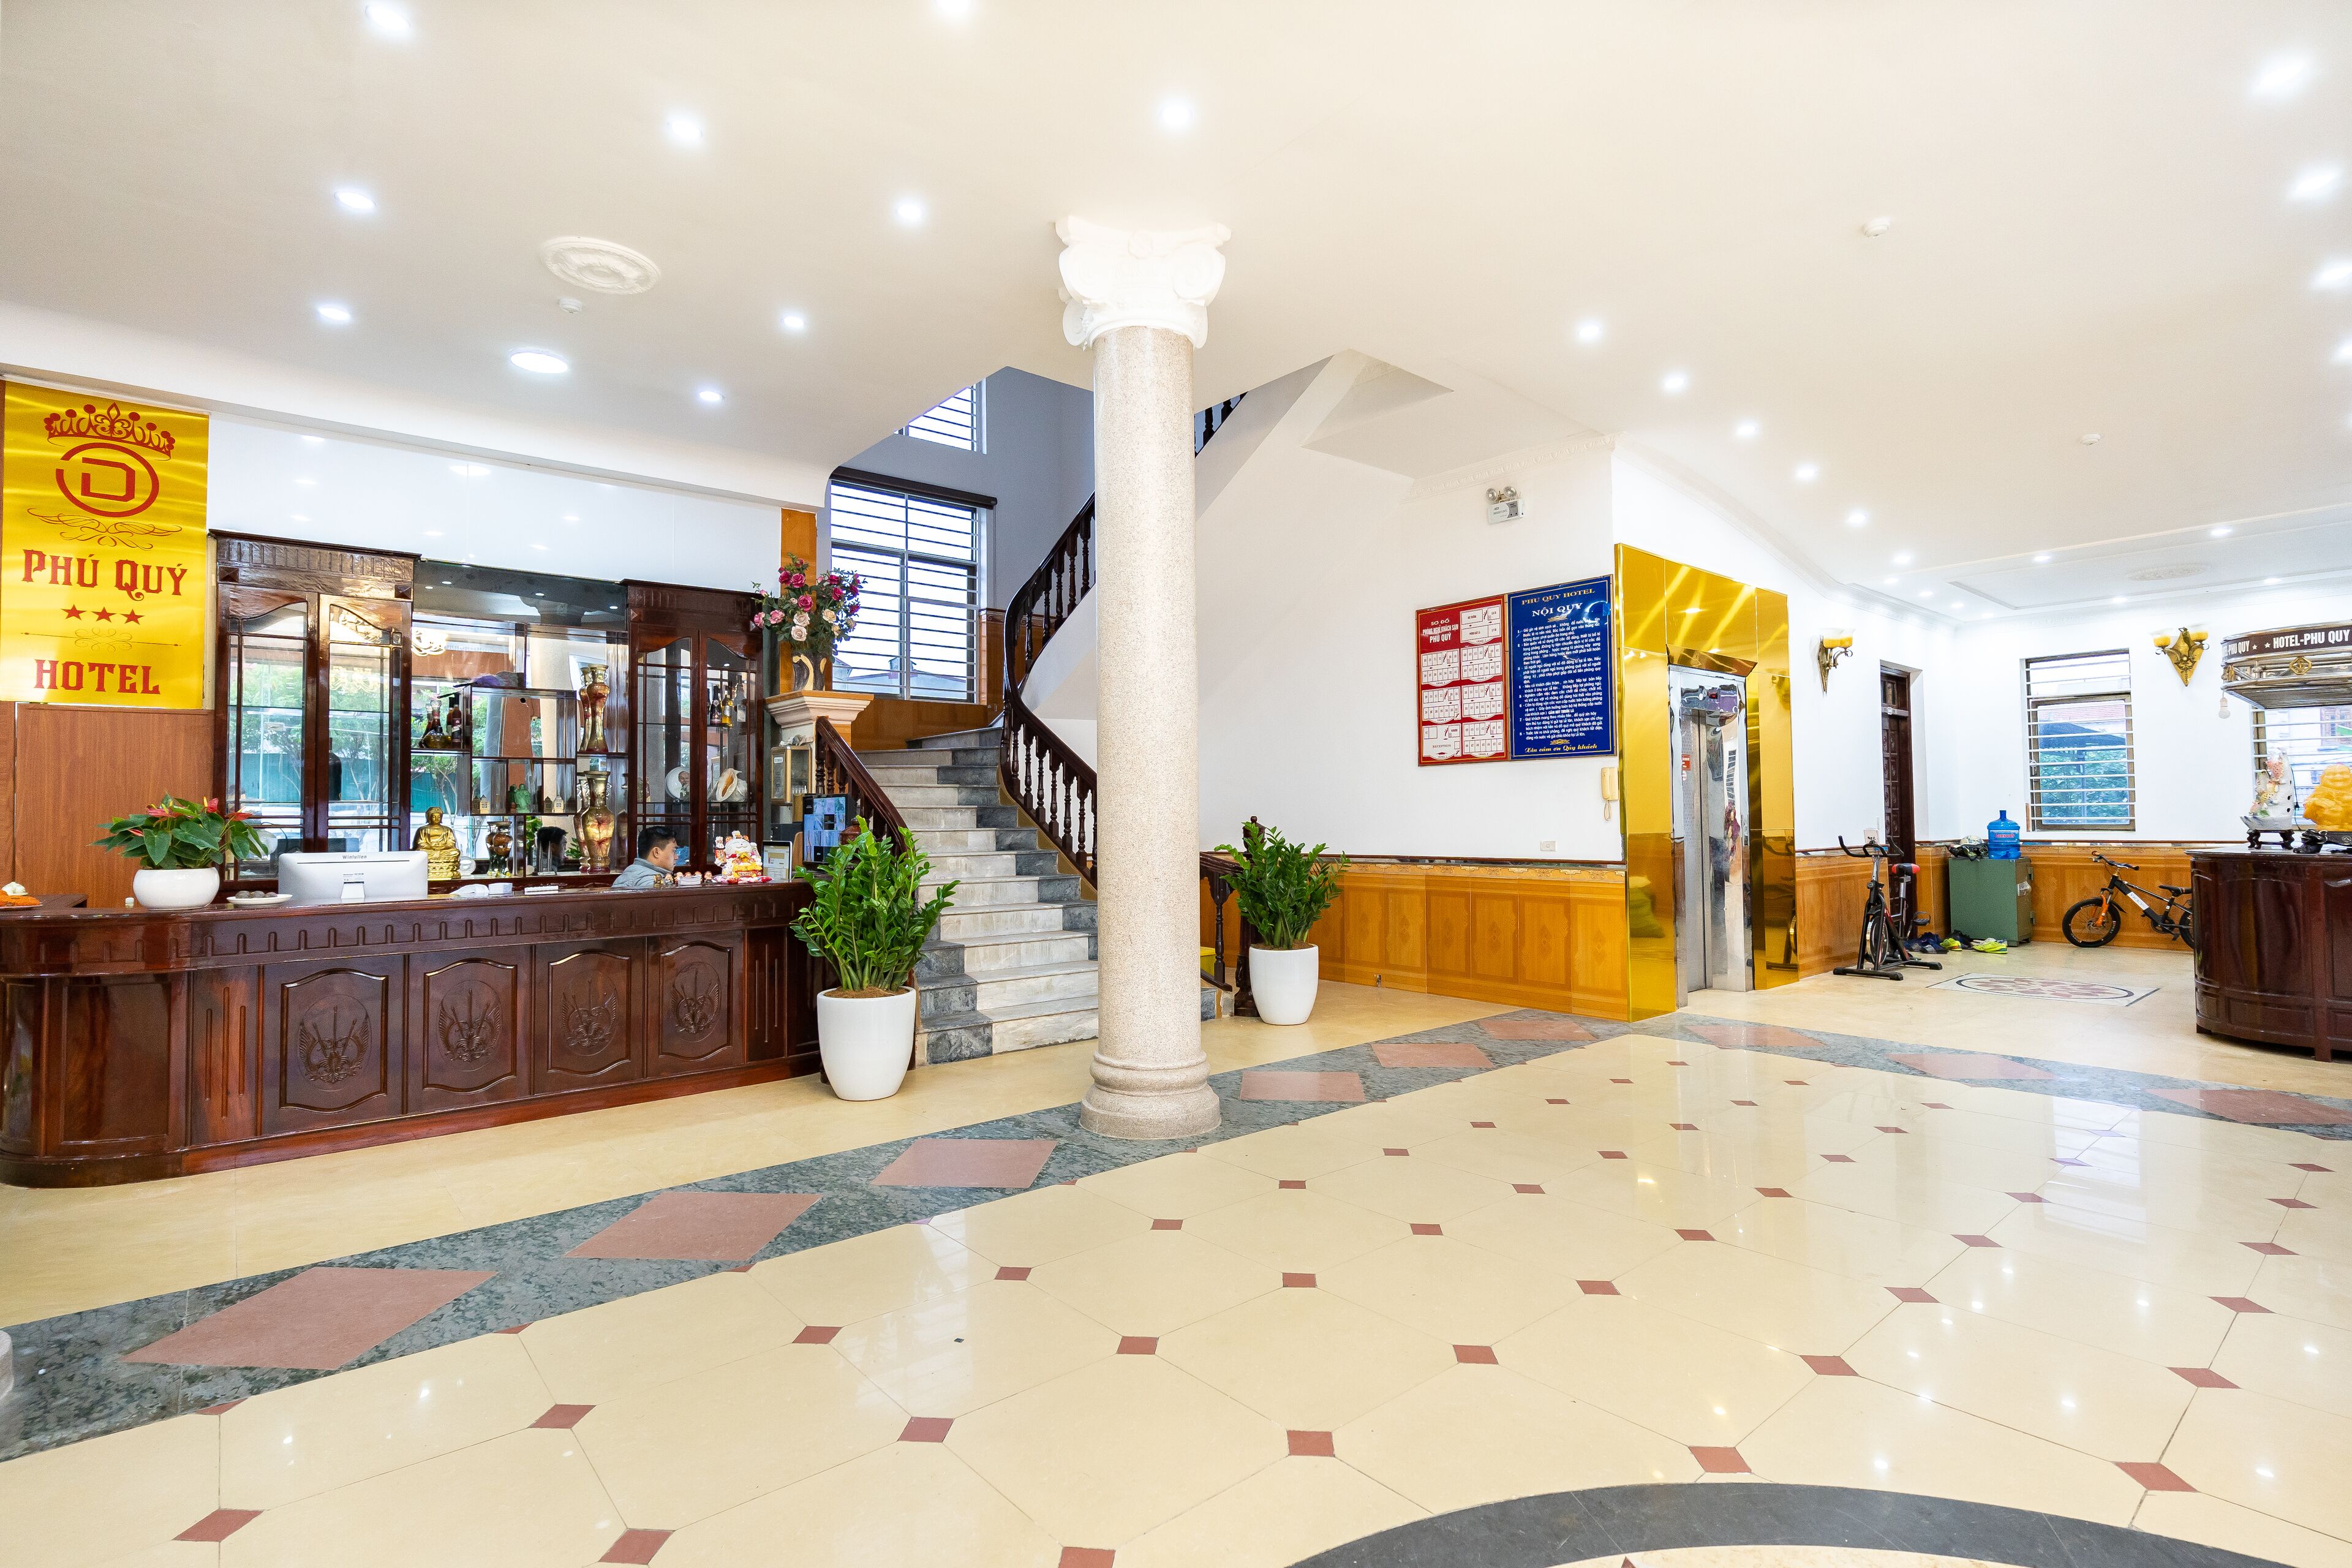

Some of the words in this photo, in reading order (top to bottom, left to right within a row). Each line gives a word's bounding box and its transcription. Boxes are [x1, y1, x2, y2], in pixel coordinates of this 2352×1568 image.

[21, 549, 100, 588] PHÚ
[114, 559, 188, 601] QUÝ
[1564, 589, 1594, 597] HOTEL
[1532, 607, 1553, 616] NỘI
[2237, 640, 2250, 654] QUY
[2273, 632, 2325, 649] HOTEL-PHU
[2328, 629, 2350, 644] QUY
[34, 659, 160, 695] HOTEL
